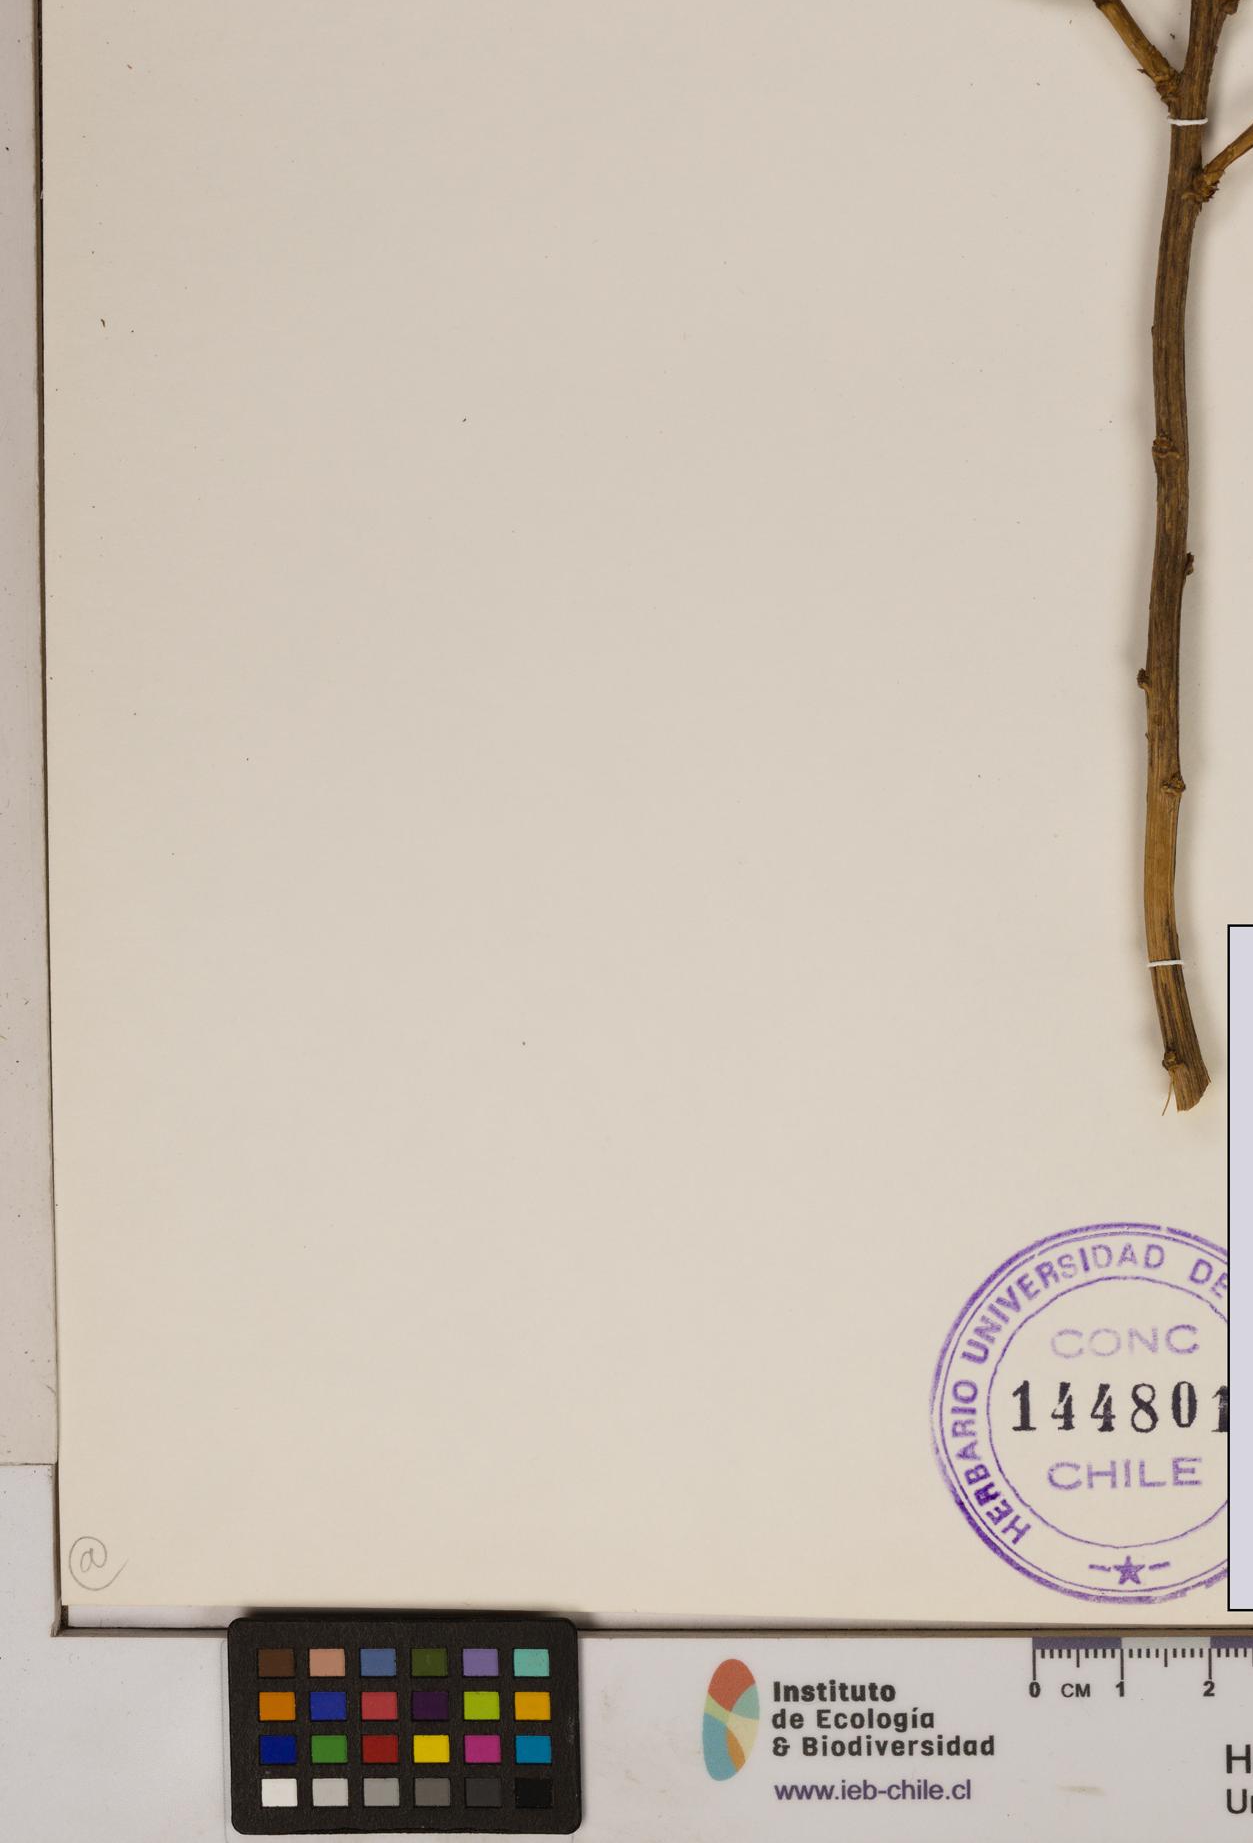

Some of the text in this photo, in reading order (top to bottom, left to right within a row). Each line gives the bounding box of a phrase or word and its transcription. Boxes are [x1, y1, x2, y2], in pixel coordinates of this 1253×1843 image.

[961, 1244, 1165, 1365] UNIVERSIDAD
[1050, 1324, 1200, 1358] CONC
[951, 1379, 1031, 1545] HERBARIO
[1046, 1457, 1203, 1490] CHILE
[773, 1679, 897, 1703] Instituto
[1028, 1679, 1041, 1699] 0
[1060, 1682, 1091, 1698] CM
[1115, 1680, 1125, 1698] 1
[1202, 1678, 1215, 1697] 2
[771, 1706, 935, 1734] de Ecología
[772, 1734, 995, 1757] & Biodiversidad
[773, 1778, 971, 1801] www.ieb-chile.cl
